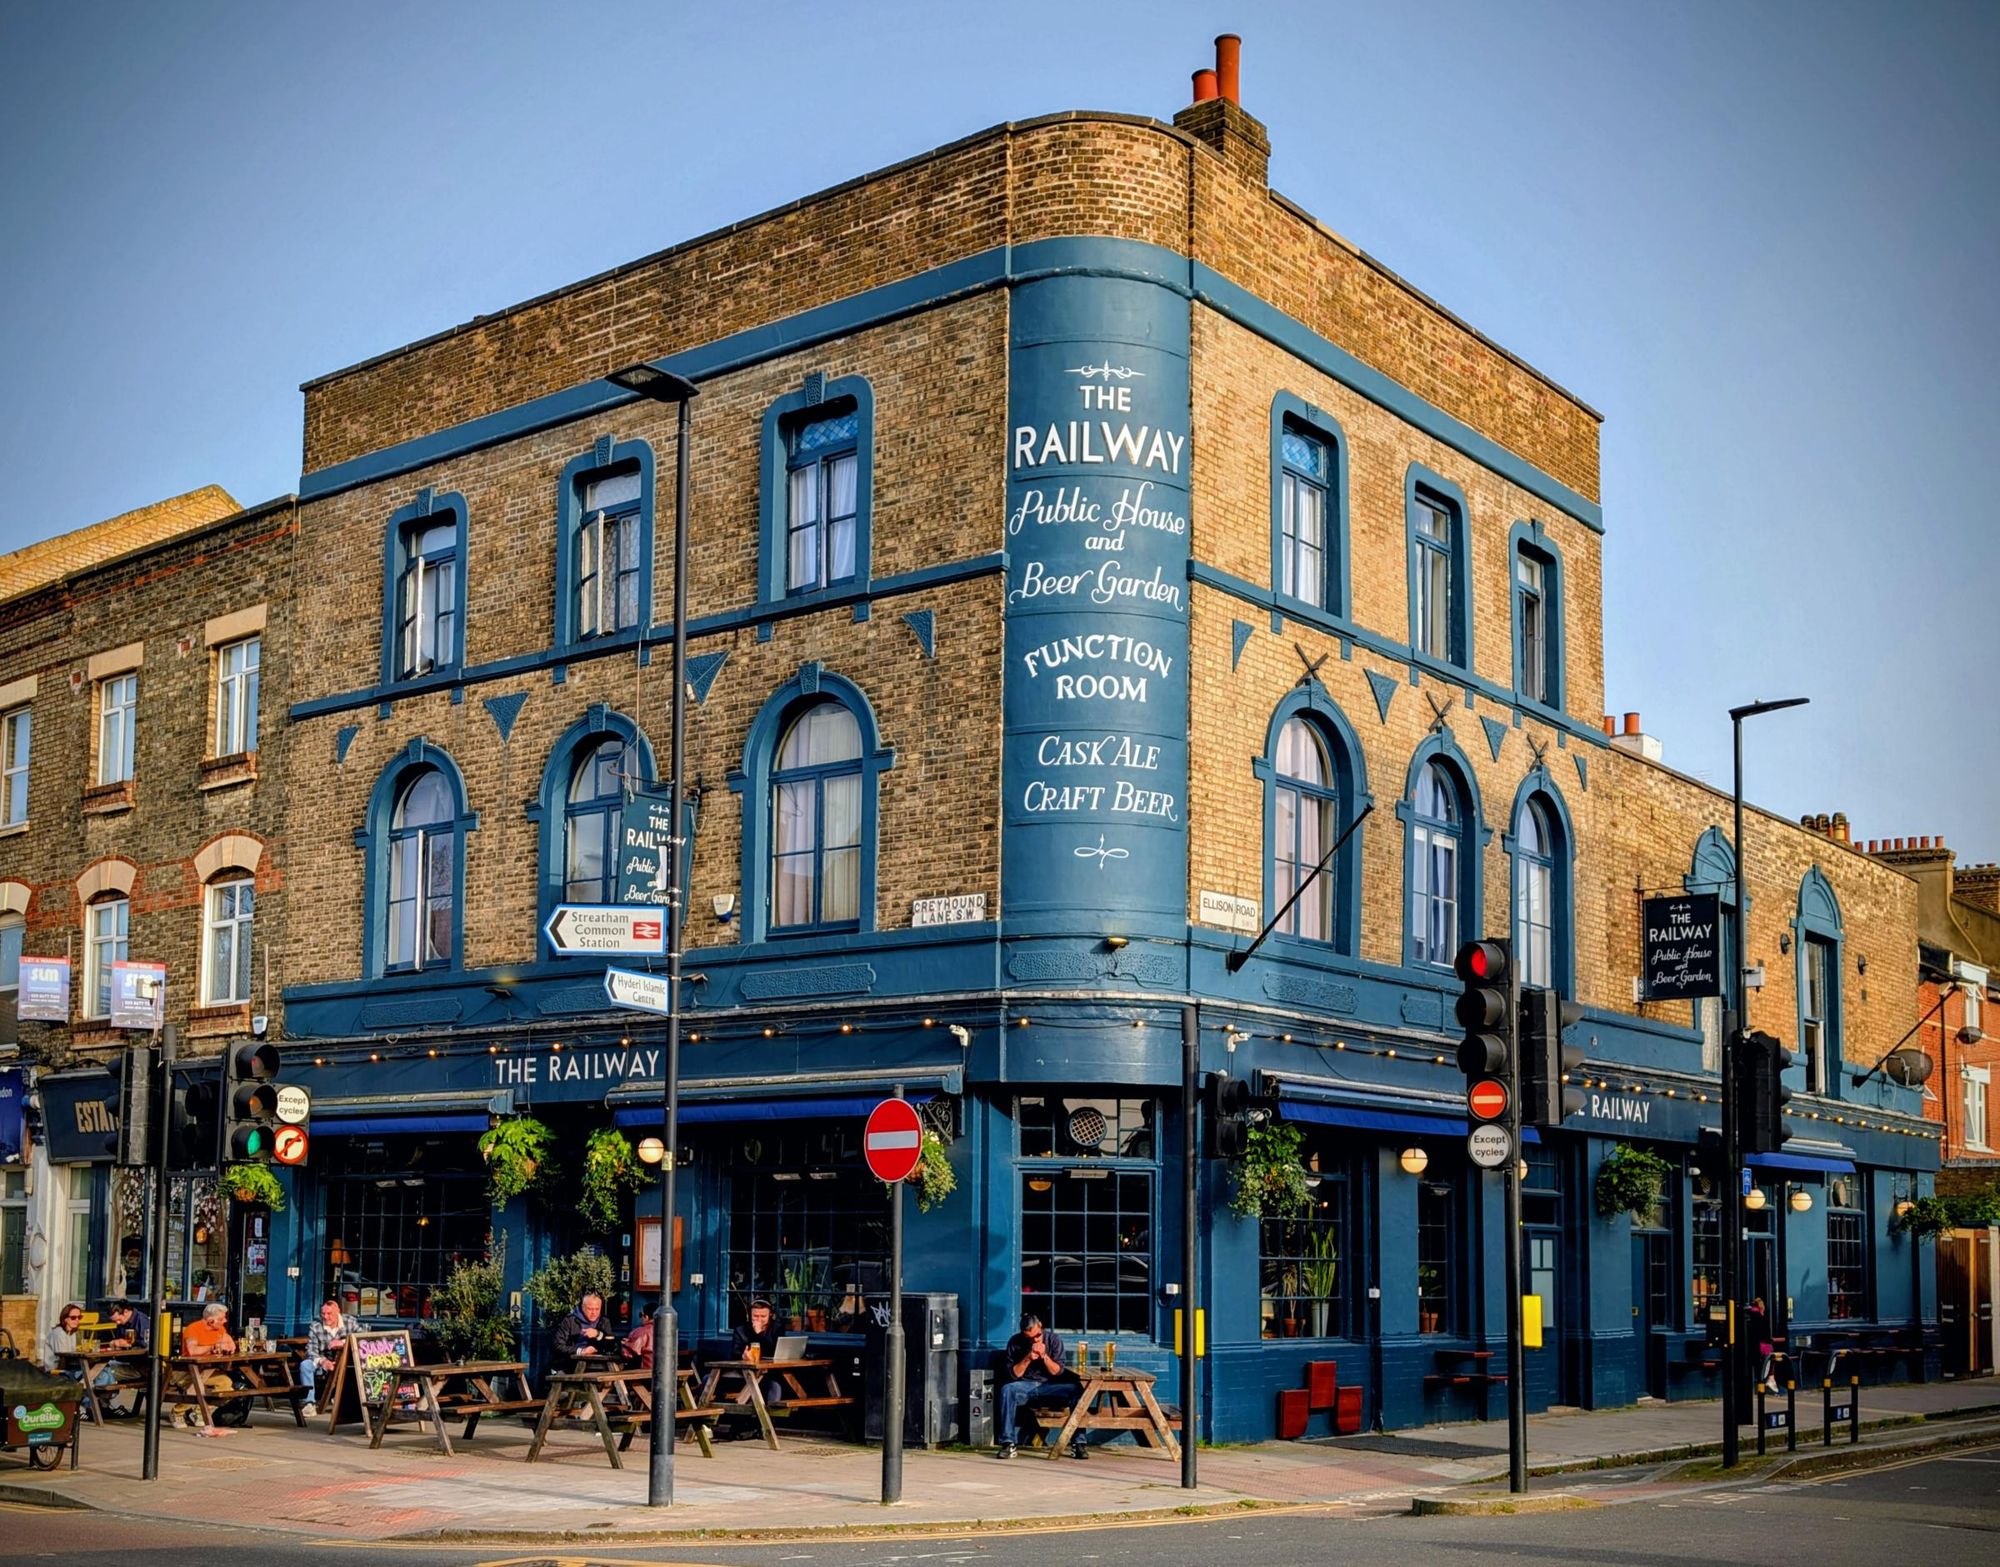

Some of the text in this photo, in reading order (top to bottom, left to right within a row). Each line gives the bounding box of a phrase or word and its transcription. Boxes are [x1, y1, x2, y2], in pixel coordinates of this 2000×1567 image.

[1079, 385, 1132, 412] THE
[1014, 421, 1185, 474] RAILWAY
[1009, 481, 1185, 535] Public House
[1085, 530, 1126, 552] and
[1009, 560, 1184, 612] Beer Garden
[1023, 634, 1173, 678] FUNCTION
[1056, 674, 1148, 702] ROOM
[1038, 735, 1161, 770] CASK ALE
[1024, 781, 1178, 821] CRAFT BEER
[648, 815, 669, 831] THE
[625, 856, 656, 875] Public
[624, 884, 651, 902] Beer
[914, 895, 983, 913] GREYHOUND
[1203, 897, 1256, 917] ELLISON ROAD
[571, 911, 629, 923] Streatham
[1670, 912, 1692, 924] THE
[574, 924, 626, 936] Common
[1649, 923, 1713, 942] RAILWAY
[579, 937, 620, 948] Station
[1651, 944, 1713, 965] Public House
[1674, 960, 1689, 971] and
[617, 976, 666, 995] Hyderi Islamic
[1652, 968, 1713, 987] Beer Garden
[632, 991, 656, 1005] Centre
[495, 1050, 659, 1084] THE RAILWAY
[279, 1094, 306, 1105] Except
[1591, 1094, 1650, 1124] RAILWAY
[279, 1107, 305, 1115] cycles
[1473, 1134, 1506, 1145] Except
[1475, 1147, 1505, 1158] cycles
[358, 1337, 395, 1359] SUNDAY
[366, 1352, 401, 1369] ROASTS
[22, 1411, 61, 1424] OurBike
